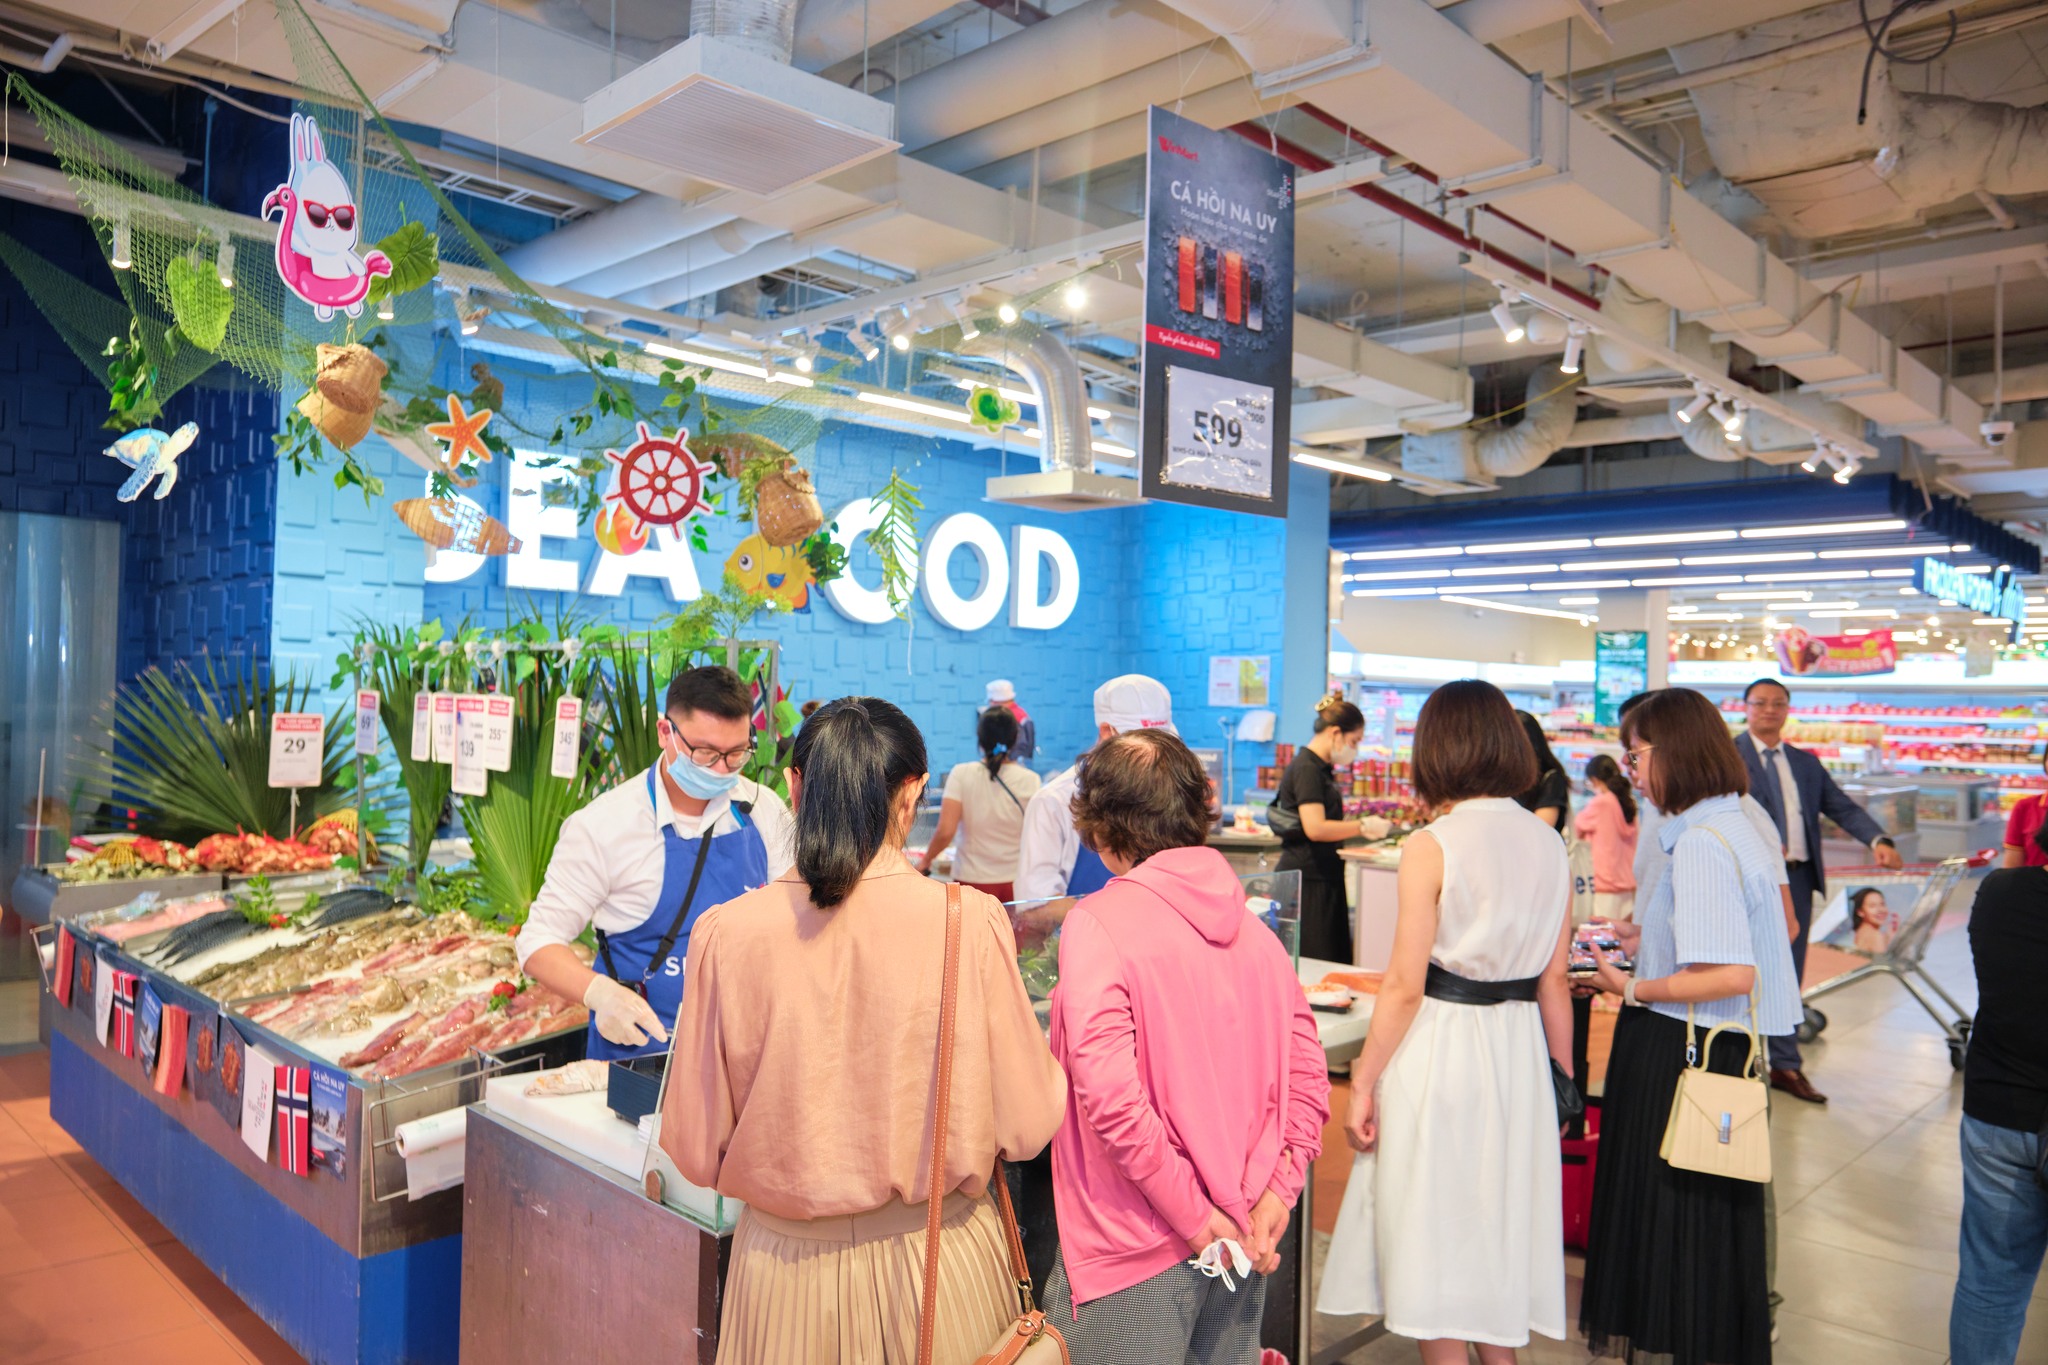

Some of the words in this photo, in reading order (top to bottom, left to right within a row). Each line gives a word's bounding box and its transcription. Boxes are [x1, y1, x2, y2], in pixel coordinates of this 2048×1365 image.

[1170, 180, 1192, 204] CÁ
[1197, 187, 1226, 217] HỒI
[1230, 202, 1252, 226] NA
[1256, 211, 1278, 233] UY
[1193, 410, 1242, 448] 599
[424, 447, 1080, 632] EAOOD
[284, 738, 306, 753] 29
[460, 739, 475, 757] 139
[312, 1069, 321, 1081] CÁ
[330, 1077, 338, 1089] NA
